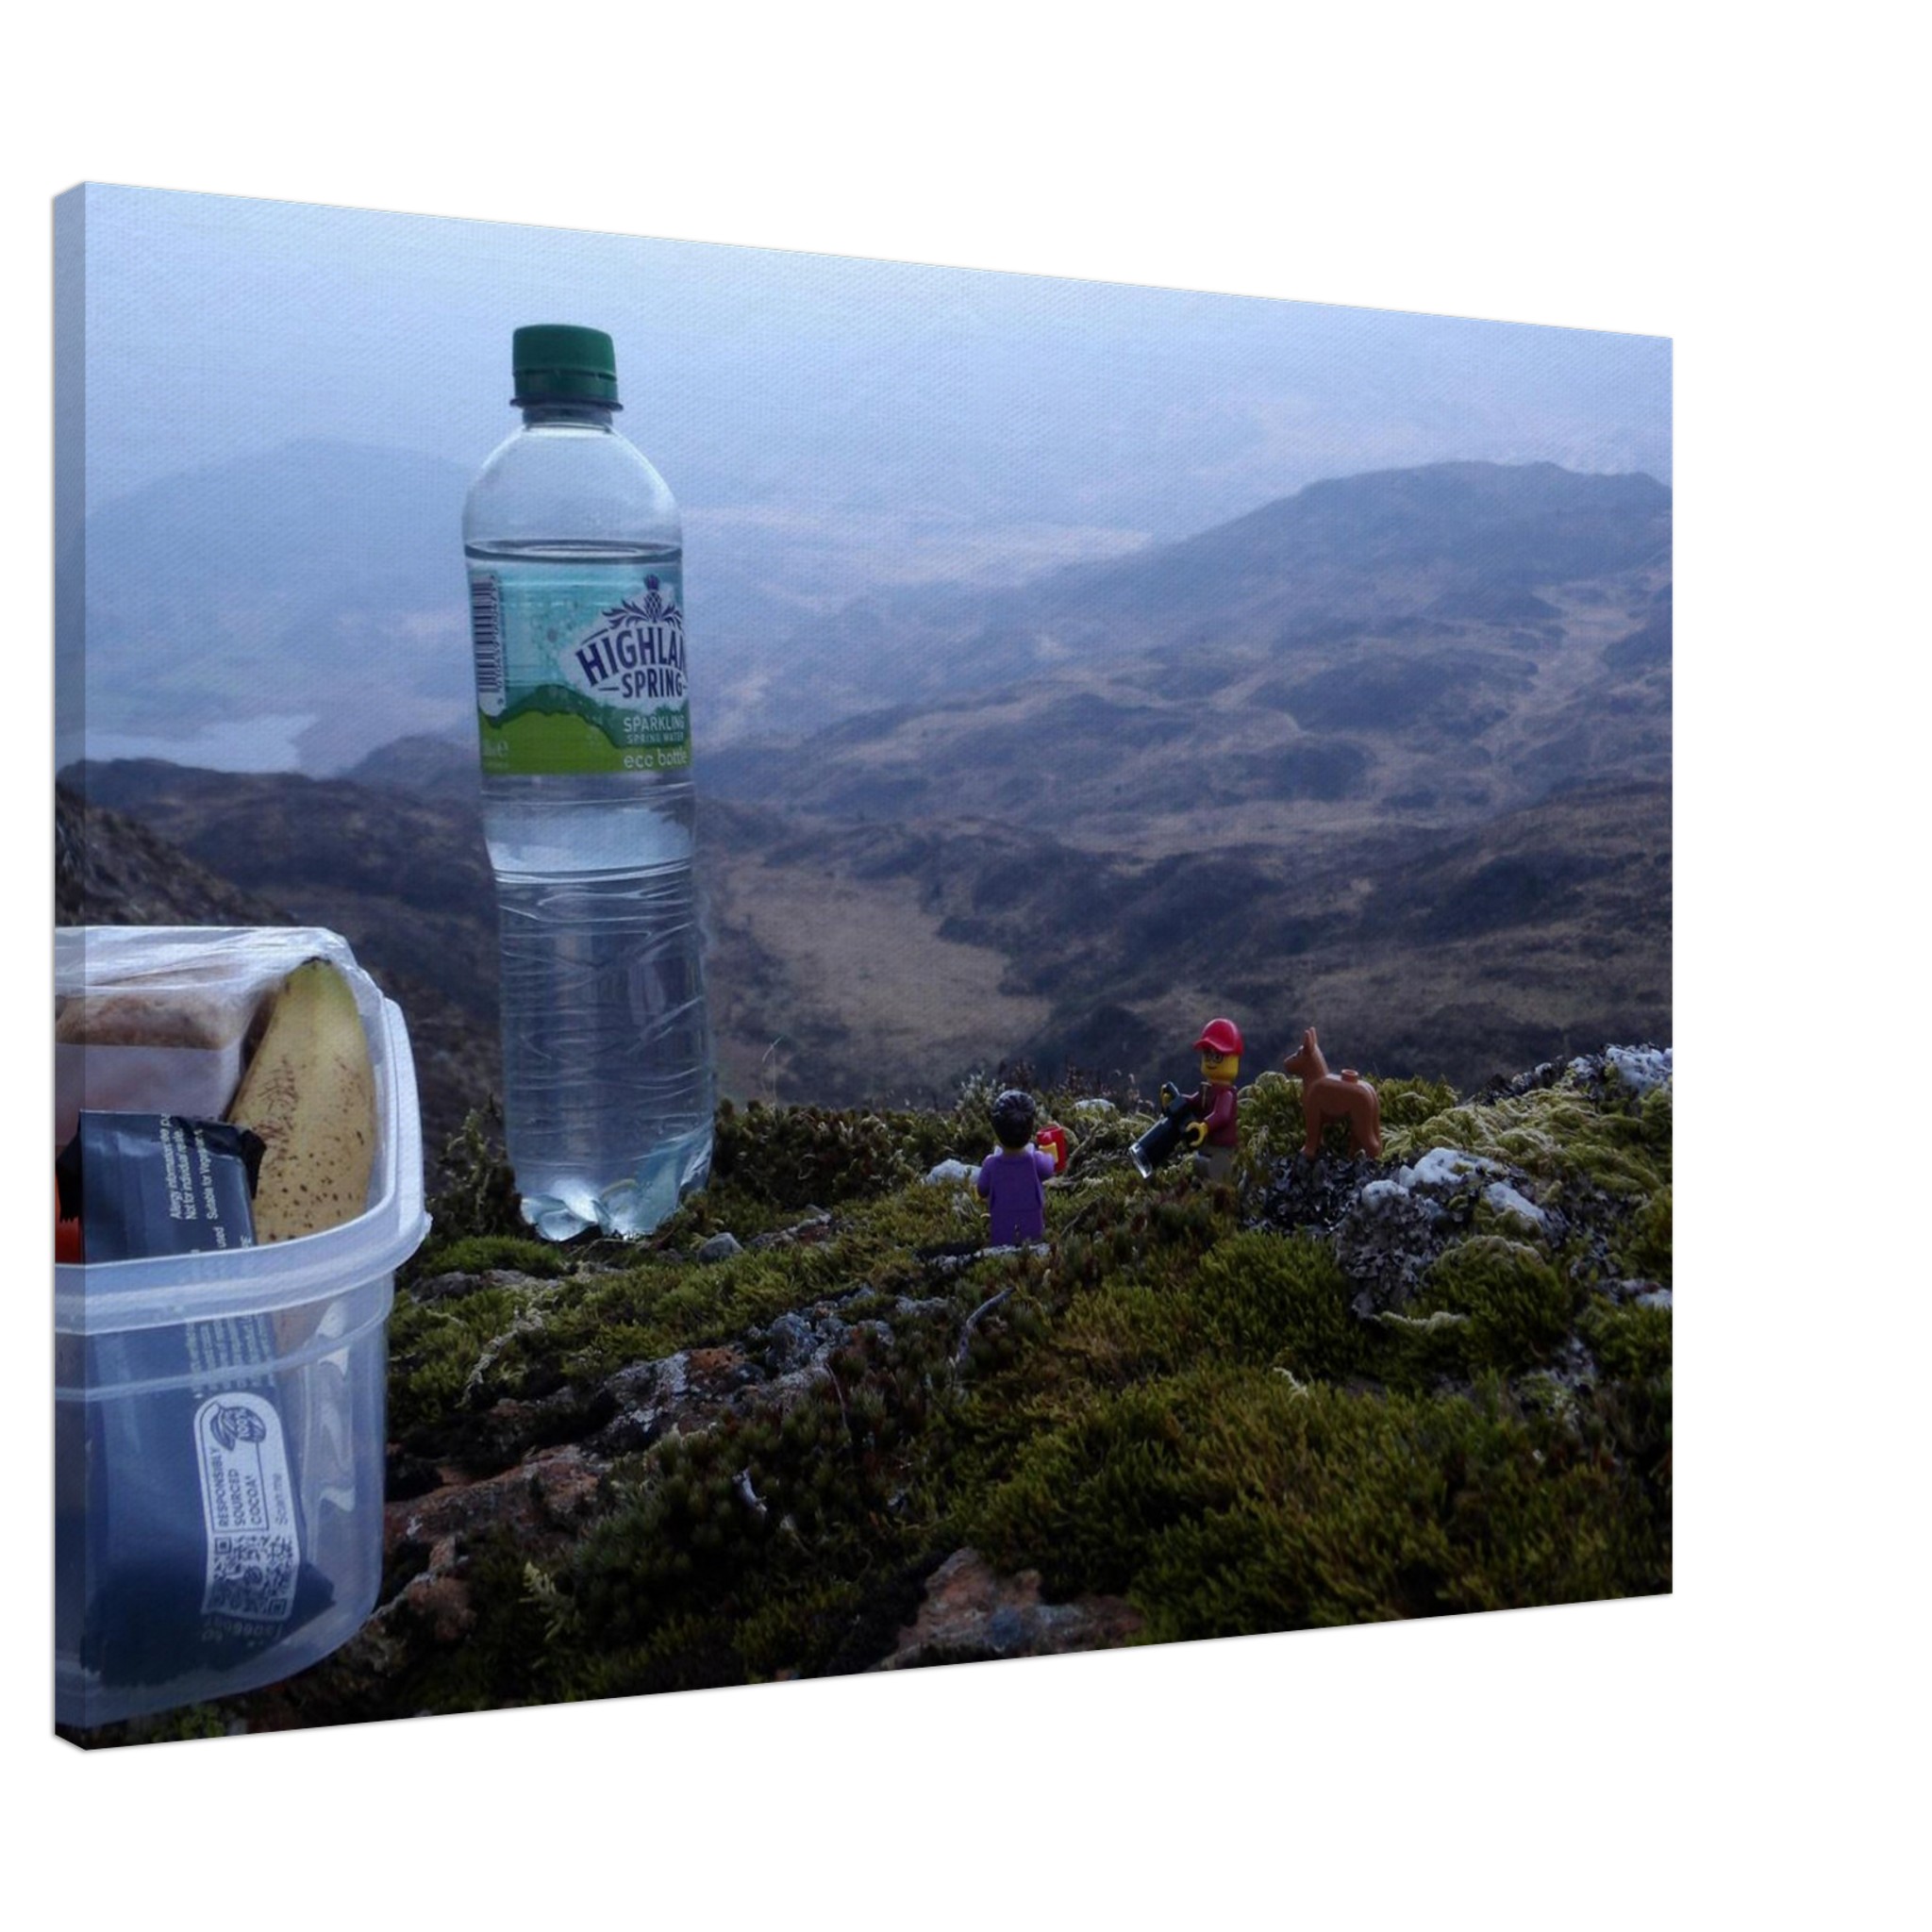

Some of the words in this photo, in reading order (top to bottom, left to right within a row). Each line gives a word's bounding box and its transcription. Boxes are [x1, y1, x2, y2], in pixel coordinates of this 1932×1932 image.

[622, 668, 683, 699] SPRING
[623, 714, 685, 733] SPARKLING
[624, 755, 654, 770] eco
[657, 746, 689, 767] bottle
[176, 1153, 192, 1191] individual
[201, 1174, 212, 1186] for
[170, 1190, 182, 1220] Allergy
[183, 1191, 194, 1204] for
[184, 1204, 198, 1220] Not
[204, 1187, 218, 1220] Suitable
[208, 1446, 229, 1527] RESPONSIBLY
[227, 1468, 247, 1526] SOURCED
